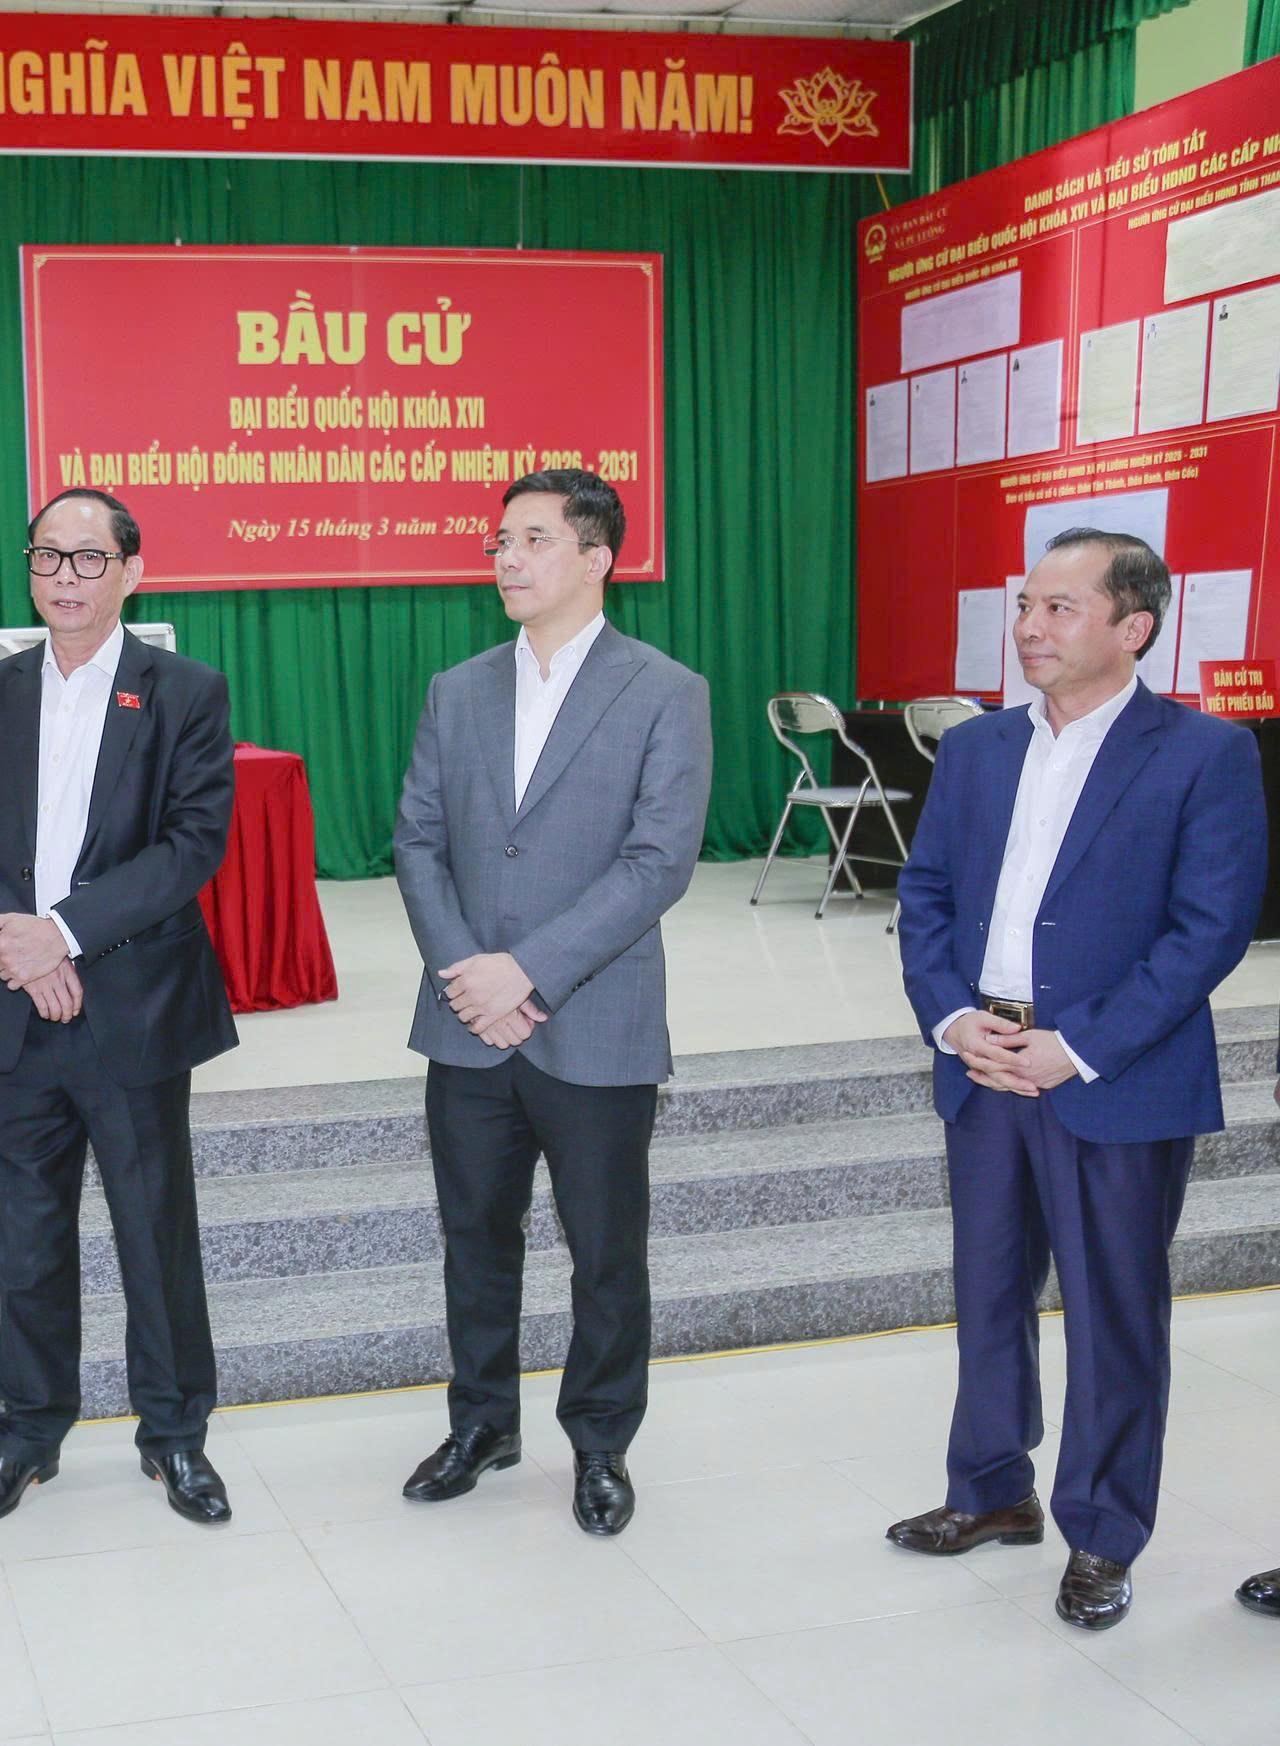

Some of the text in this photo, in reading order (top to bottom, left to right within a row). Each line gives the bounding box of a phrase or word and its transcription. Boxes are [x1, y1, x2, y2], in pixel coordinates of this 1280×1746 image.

[163, 42, 285, 130] VIỆT
[303, 58, 431, 123] NAM
[450, 53, 604, 129] MUÔN
[621, 57, 754, 134] NĂM!
[1055, 175, 1085, 200] SÁCH
[1087, 168, 1102, 188] VÀ
[1153, 141, 1180, 166] TÓM
[1070, 202, 1089, 222] XVI
[1091, 193, 1106, 216] VÀ
[1200, 157, 1228, 178] CÁC
[237, 289, 473, 366] BẦU CỬ
[229, 383, 486, 437] ĐẠI BIỂU QUỐC HỘI KHÓA XVI
[59, 447, 88, 488] VÀ
[89, 452, 124, 494] ĐẠI
[127, 439, 173, 486] BIỂU
[176, 445, 209, 493] HỘI
[270, 444, 323, 485] NHÂN
[326, 444, 365, 484] DÂN
[369, 445, 407, 484] CÁC
[410, 438, 448, 483] CẤP
[451, 443, 511, 489] NHIỆM
[513, 443, 537, 482] KỲ
[598, 450, 638, 482] 2031
[227, 516, 489, 542] Ngày 15 tháng 3 năm 2026
[1206, 691, 1226, 713] VIẾT
[1227, 690, 1255, 712] PHIẾU
[1248, 669, 1263, 687] TRI
